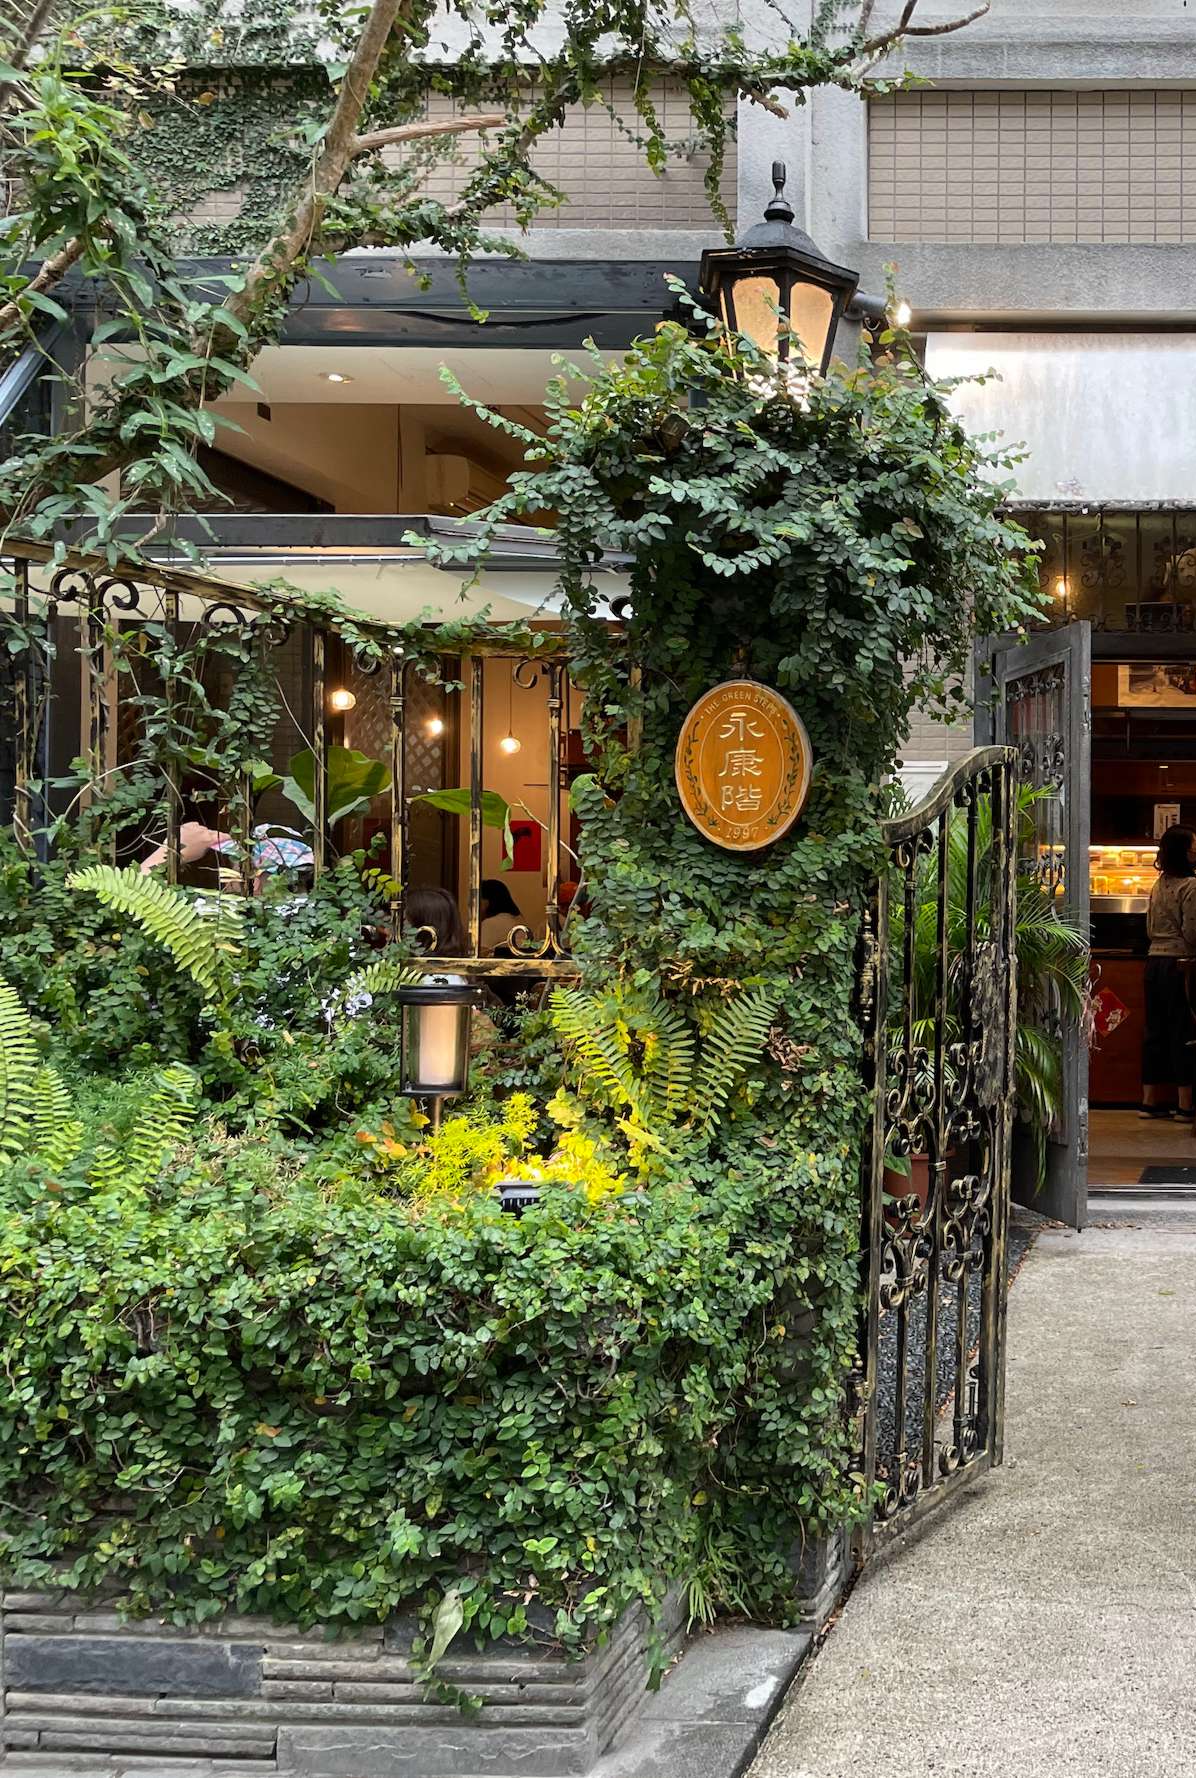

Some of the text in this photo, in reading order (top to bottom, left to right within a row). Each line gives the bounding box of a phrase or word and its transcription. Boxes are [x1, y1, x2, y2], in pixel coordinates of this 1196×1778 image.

[704, 700, 720, 715] THE
[722, 691, 752, 702] GREEN
[718, 712, 765, 811] 永康階
[725, 826, 760, 840] 1997
